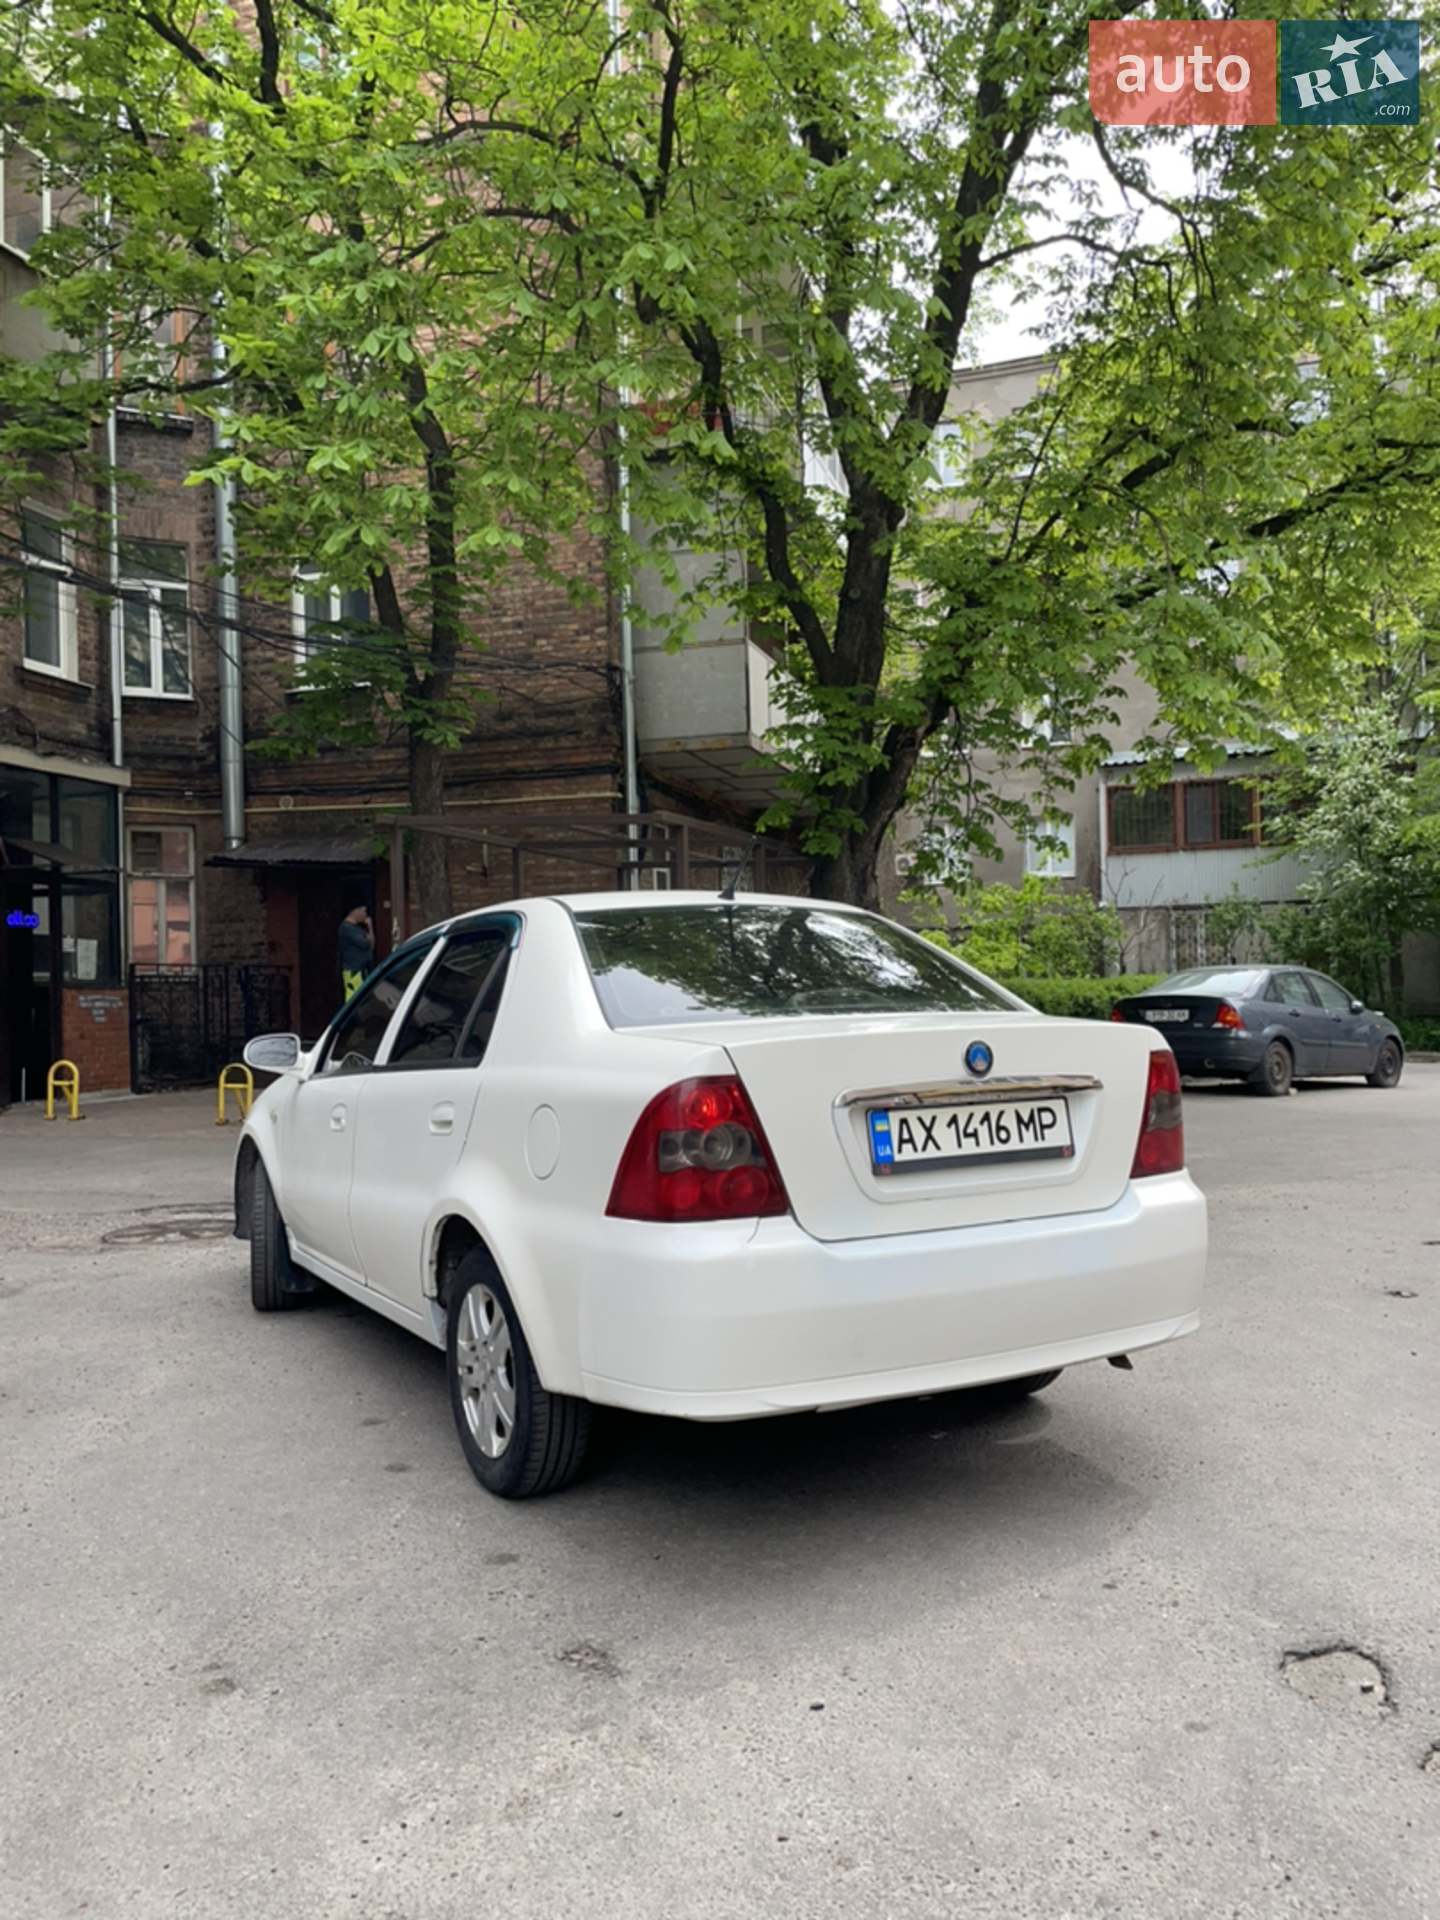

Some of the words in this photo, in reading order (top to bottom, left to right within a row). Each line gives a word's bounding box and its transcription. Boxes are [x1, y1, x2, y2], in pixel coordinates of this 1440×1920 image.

[897, 1115, 942, 1154] AX
[946, 1110, 1011, 1149] 1416
[1014, 1106, 1058, 1144] MP
[877, 1145, 893, 1157] UA
